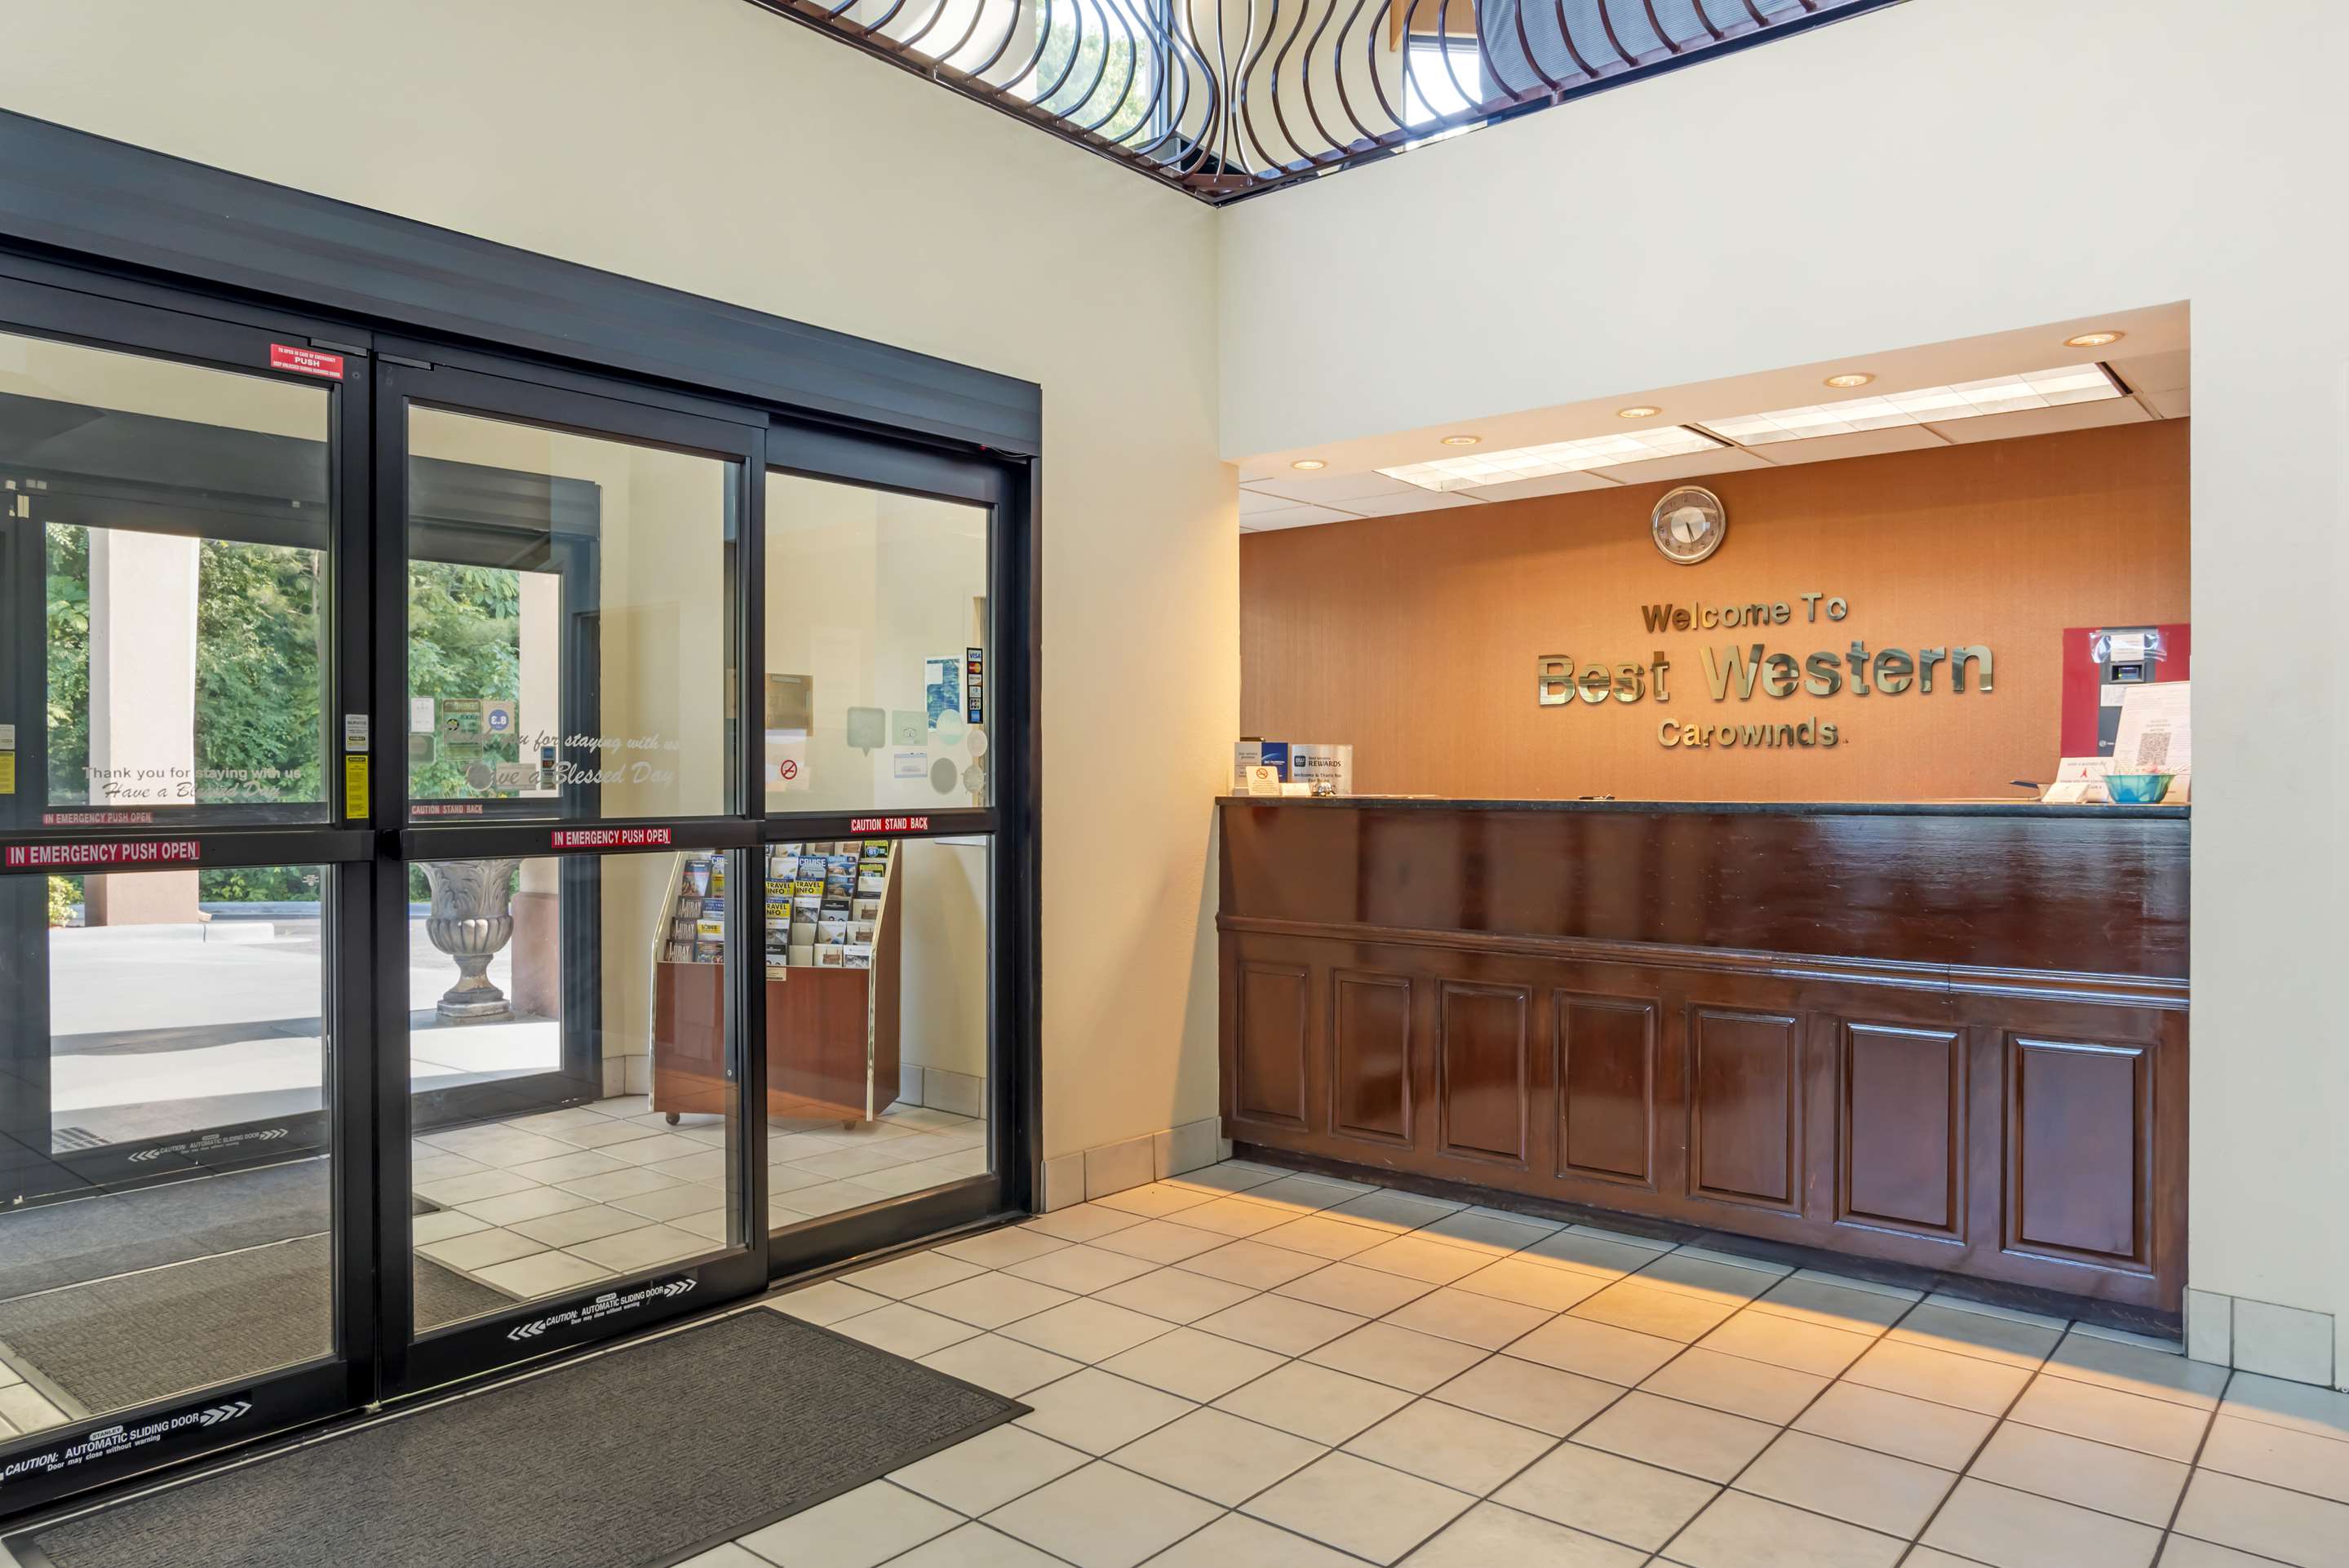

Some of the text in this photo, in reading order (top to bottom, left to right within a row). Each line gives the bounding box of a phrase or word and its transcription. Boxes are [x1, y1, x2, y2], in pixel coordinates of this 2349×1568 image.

[295, 357, 320, 367] PUSH
[1642, 592, 1848, 633] Welcome To
[1538, 640, 1994, 706] Best Western
[1657, 716, 1839, 748] Carowinds
[534, 729, 558, 751] for
[565, 733, 623, 754] staying
[627, 733, 660, 750] with
[82, 766, 302, 781] Thank you for staying with us
[552, 760, 625, 785] Blessed
[631, 761, 673, 785] Day
[102, 782, 151, 799] Have
[157, 787, 168, 798] a
[411, 804, 483, 814] CAUTION STAND BACK
[44, 813, 152, 823] IN EMERGENCY PUSH OPEN
[852, 817, 928, 831] CAUTION STAND BACK
[555, 829, 669, 845] IN EMERGENCY PUSH OPEN
[11, 841, 196, 864] IN EMERGENCY PUSH OPEN
[800, 858, 827, 867] CRUISE
[796, 880, 821, 888] TRAVEL
[680, 898, 702, 911] LURAY
[675, 919, 694, 934] LURAY
[669, 941, 689, 956] LURAY
[546, 1286, 664, 1327] CAUTION: AUTOMATIC SLIDING DOOR
[91, 1427, 122, 1440] STANLEY
[6, 1412, 199, 1477] CAUTION: AUTOMATIC SLIDING DOOR
[47, 1433, 161, 1472] Door may close without warning
